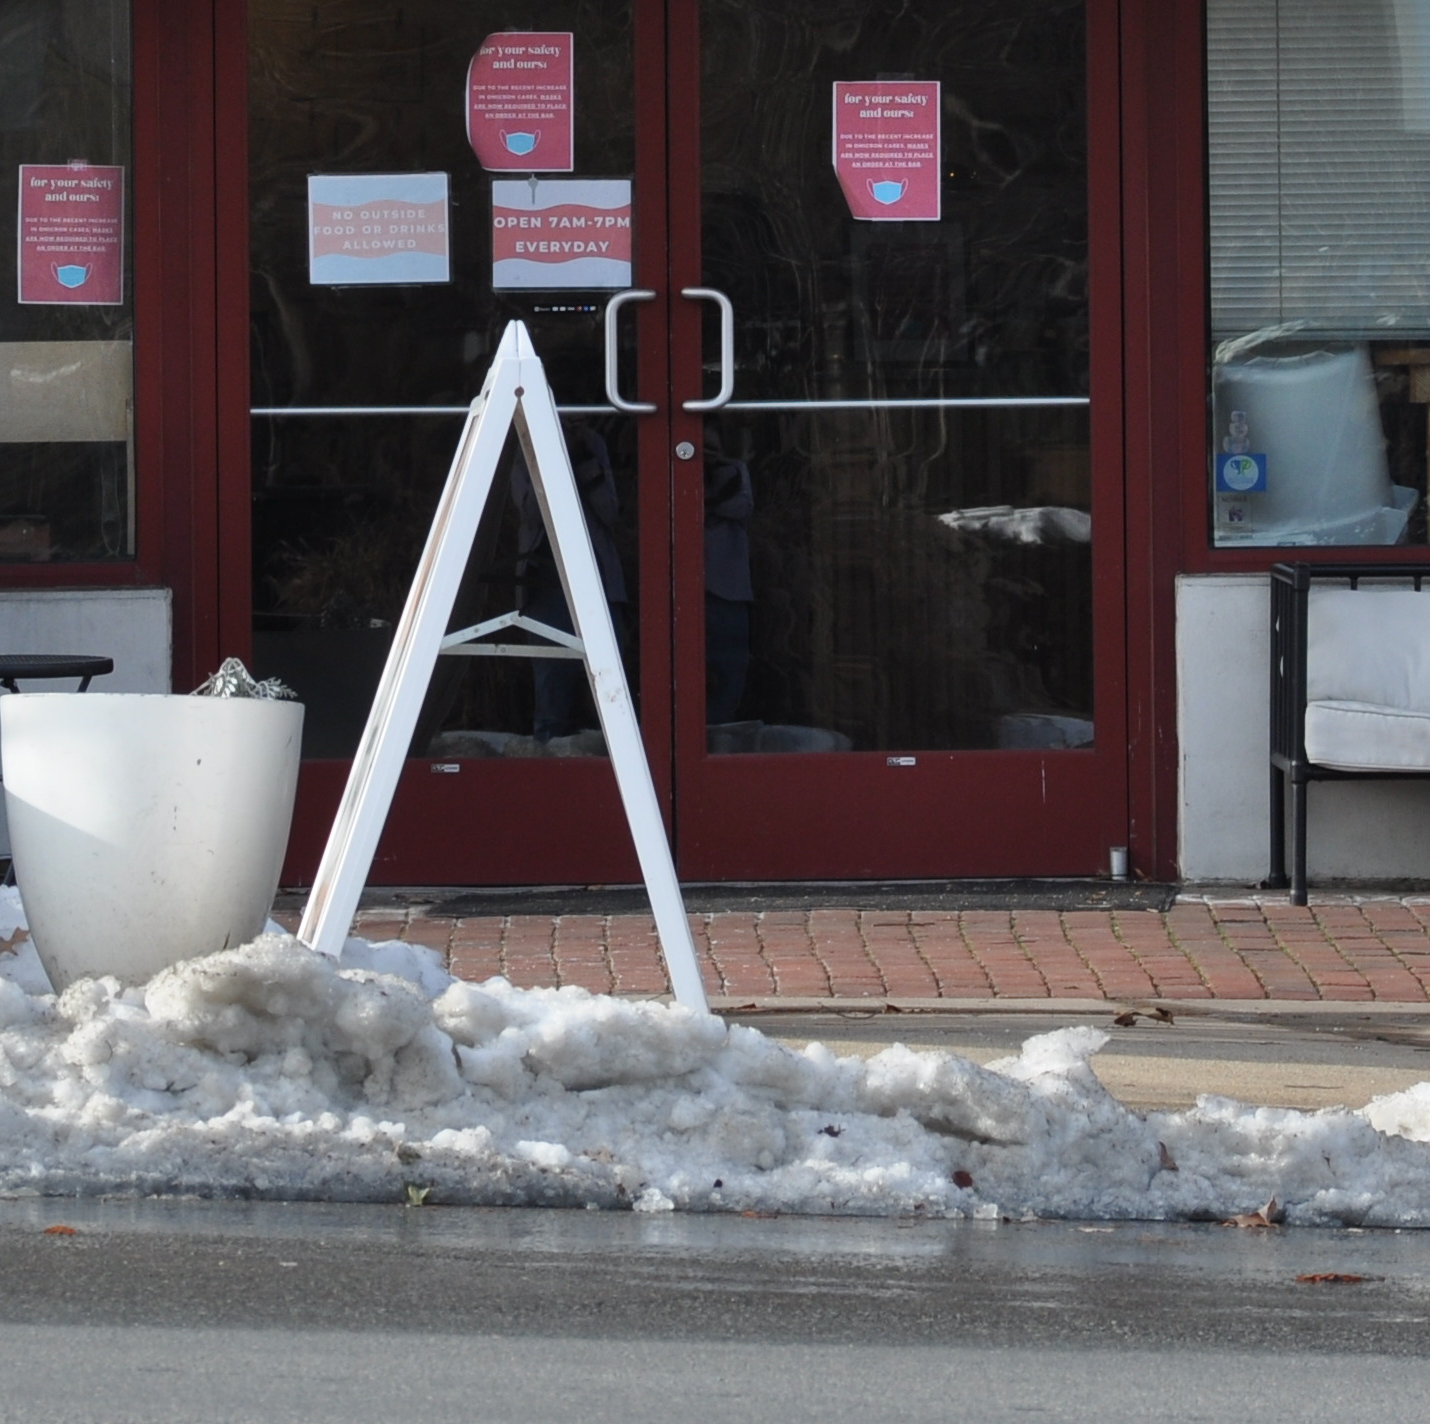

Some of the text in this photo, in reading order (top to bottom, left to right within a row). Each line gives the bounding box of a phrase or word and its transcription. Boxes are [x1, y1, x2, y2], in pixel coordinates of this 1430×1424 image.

[497, 46, 526, 57] your
[528, 44, 561, 57] safety
[493, 59, 514, 69] and
[844, 93, 928, 106] for your safety
[859, 107, 881, 118] and
[30, 176, 114, 190] for your safety
[45, 191, 67, 202] and
[332, 209, 426, 221] NO OUTSIDE
[493, 216, 631, 229] OPEN 7AM-7PM
[313, 223, 446, 236] FOOD OR DRINKS
[342, 239, 417, 250] ALLOWED
[515, 240, 610, 254] EVERYDAY
